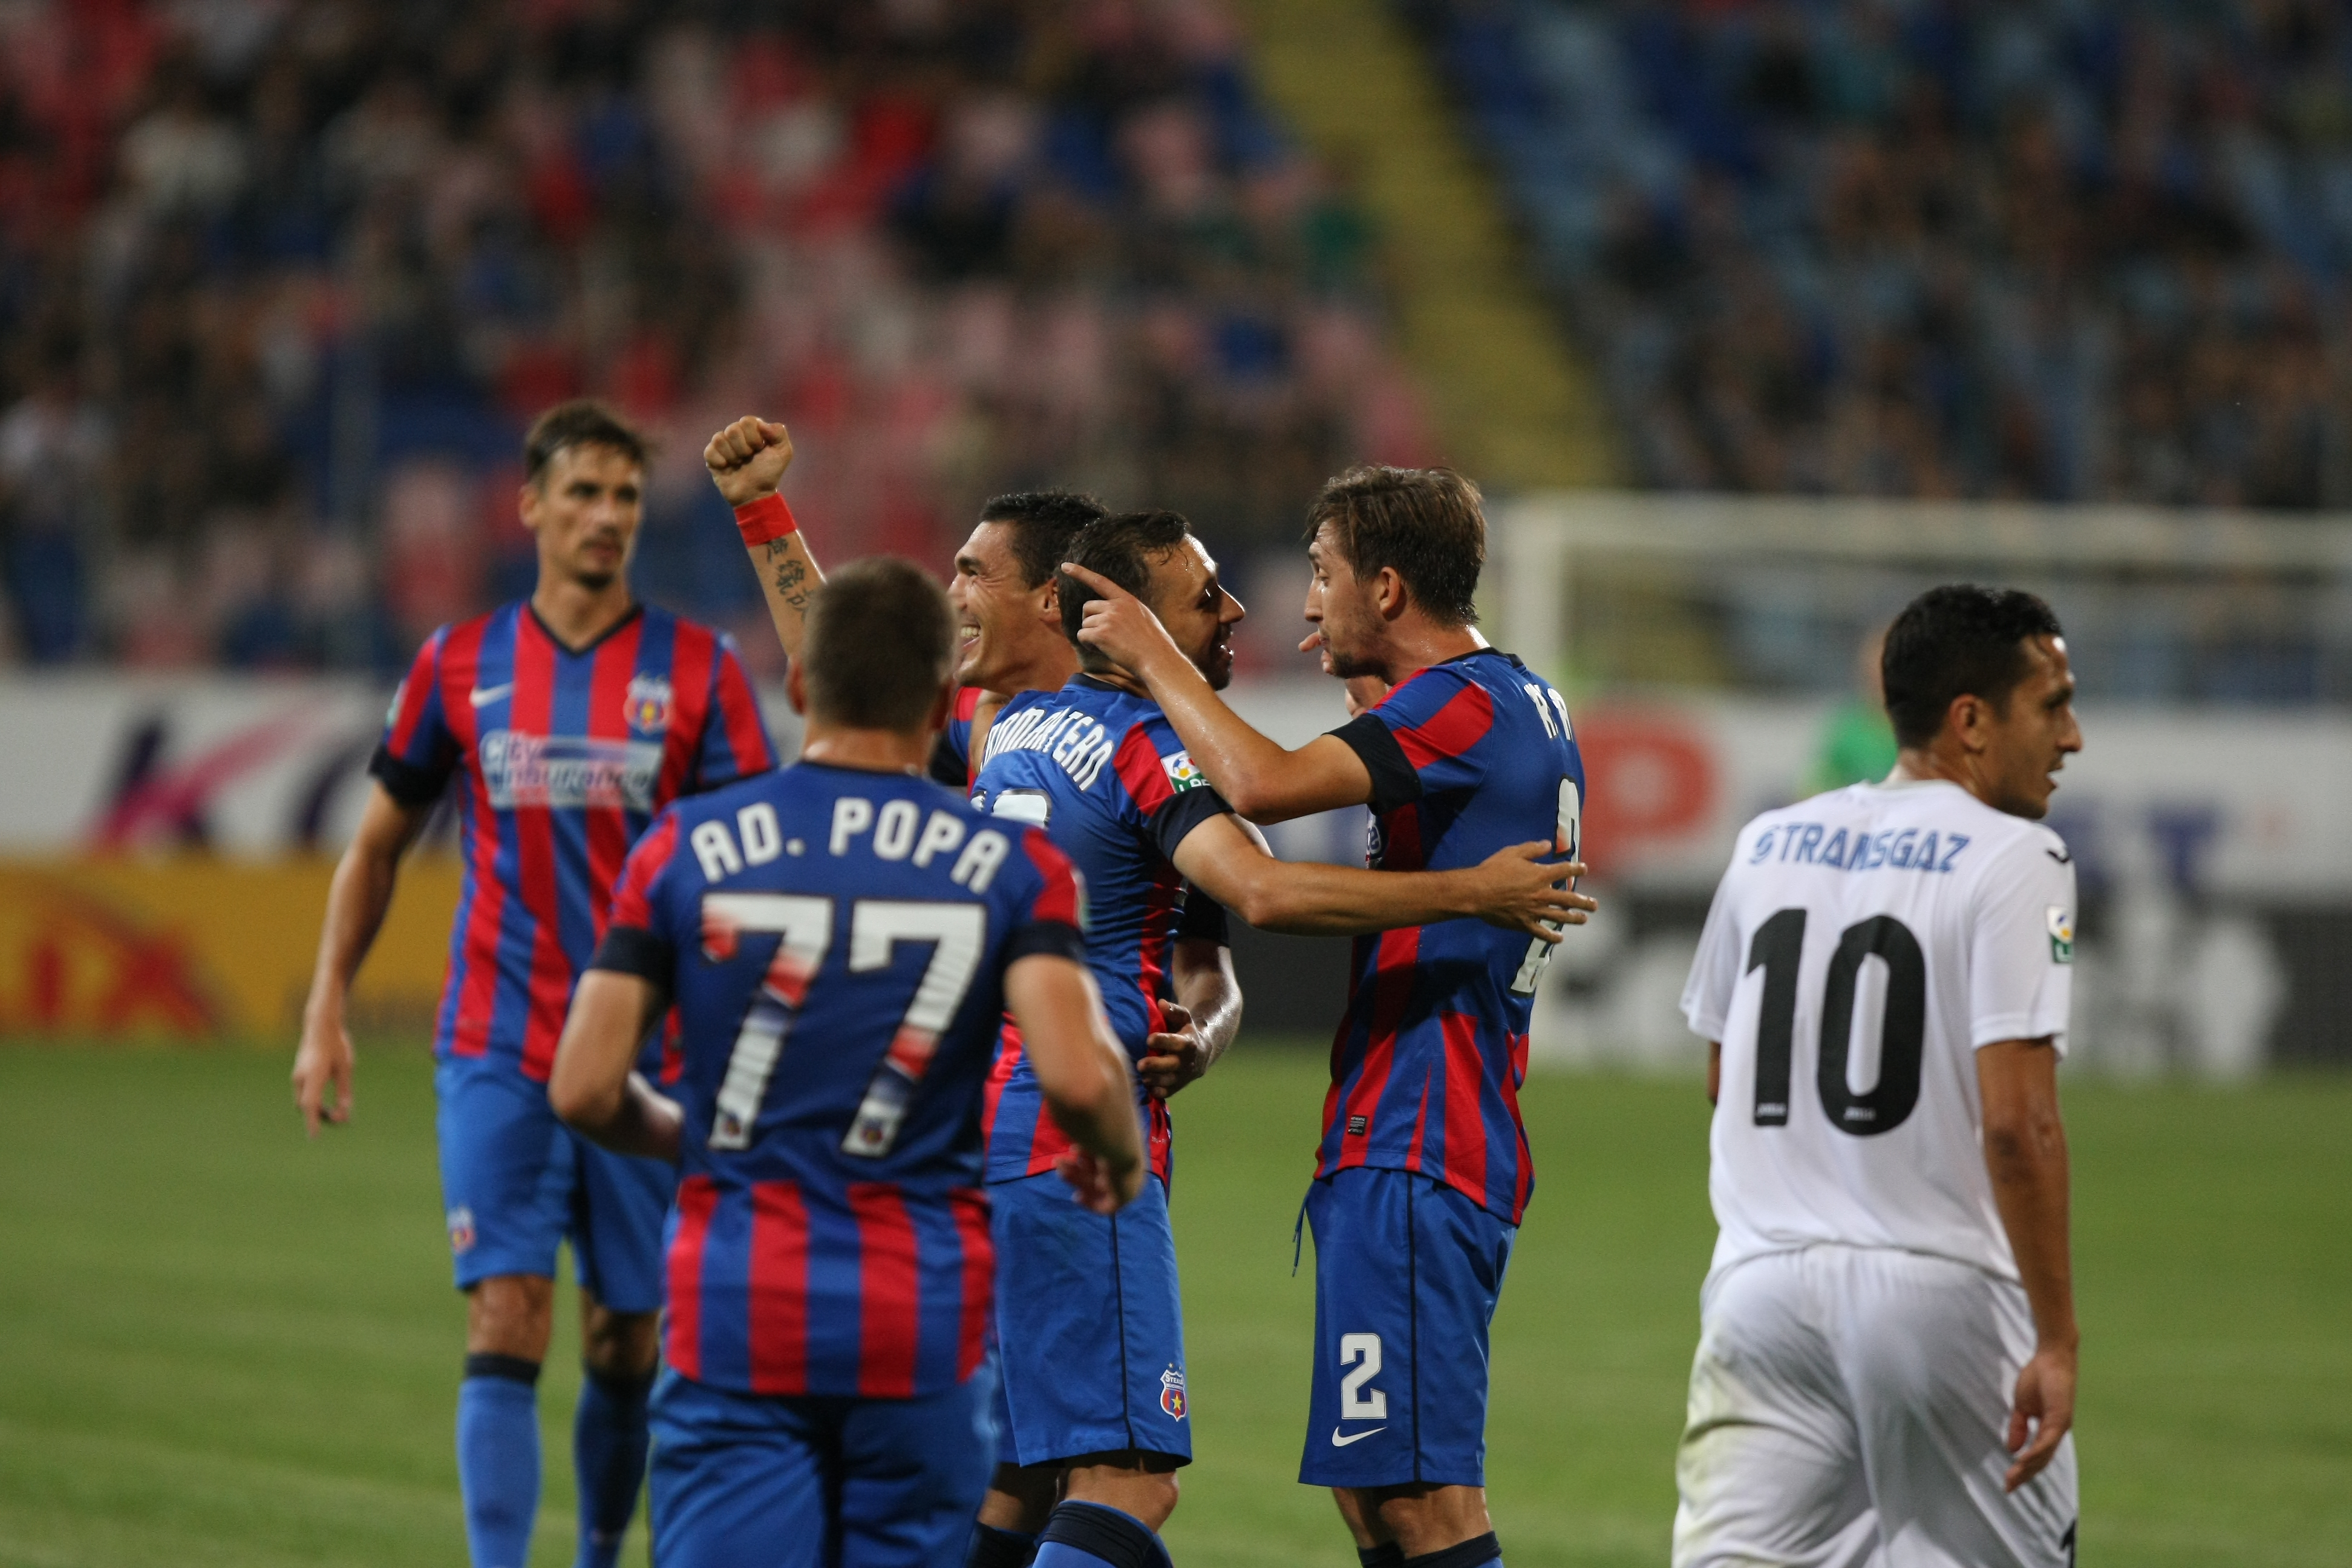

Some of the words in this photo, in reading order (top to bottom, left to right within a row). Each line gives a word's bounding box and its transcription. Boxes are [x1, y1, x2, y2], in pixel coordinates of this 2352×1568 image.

[691, 802, 805, 883] AD.
[829, 797, 1010, 893] POPA
[702, 892, 985, 1157] 77
[1744, 907, 1926, 1137] 10
[1341, 1333, 1387, 1420] 2
